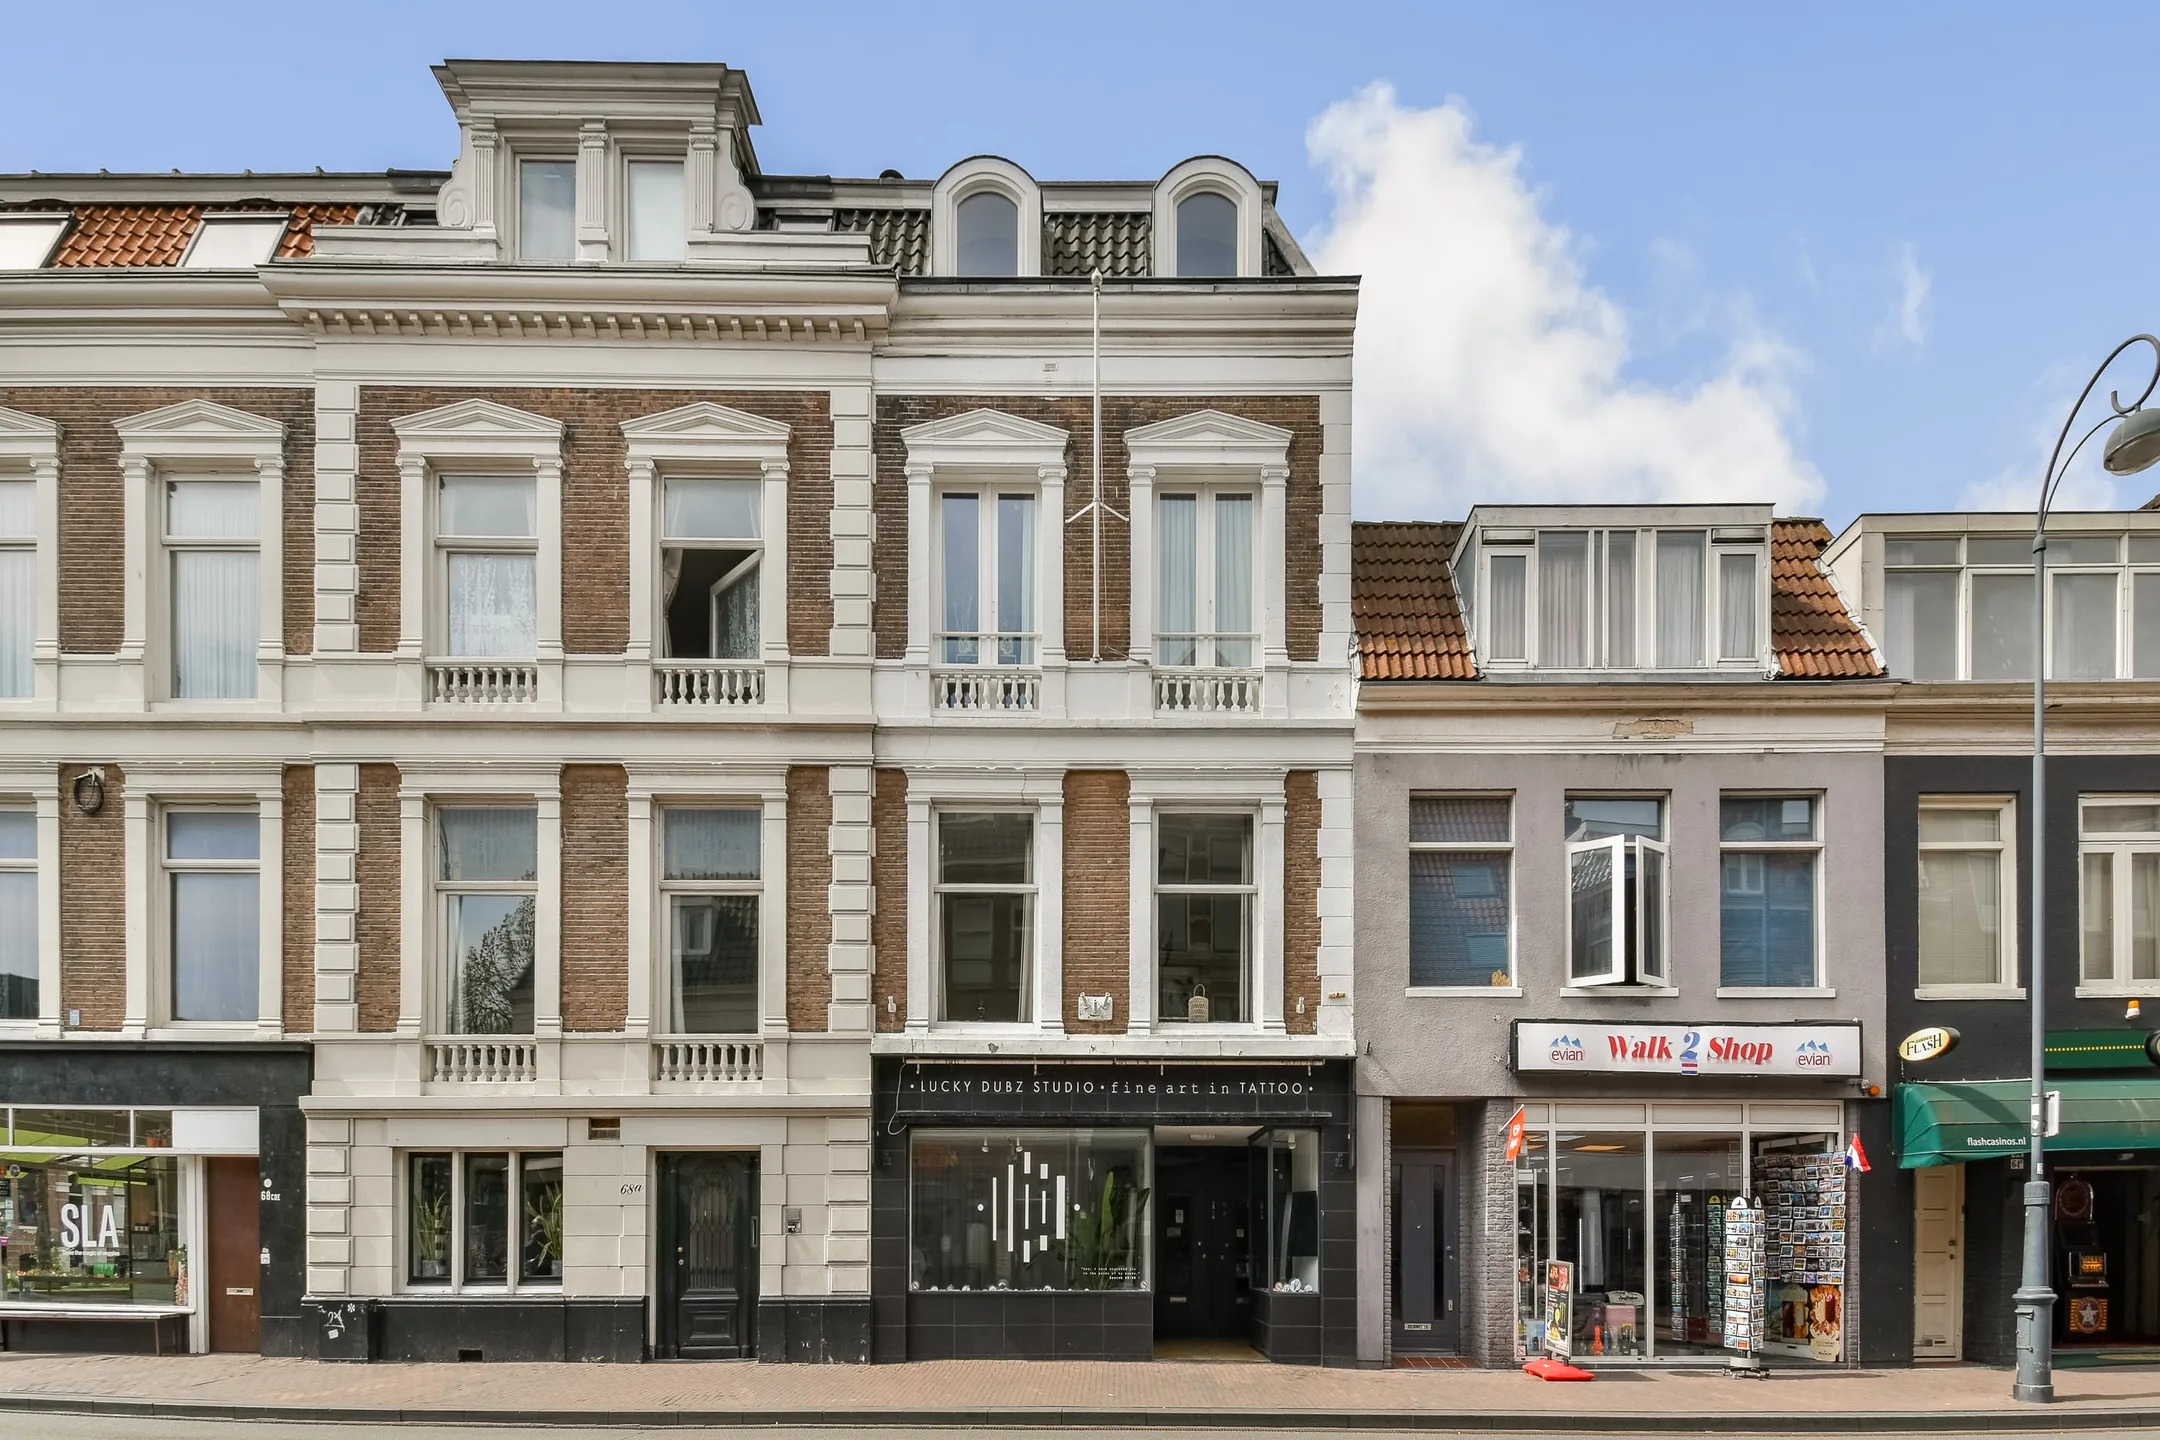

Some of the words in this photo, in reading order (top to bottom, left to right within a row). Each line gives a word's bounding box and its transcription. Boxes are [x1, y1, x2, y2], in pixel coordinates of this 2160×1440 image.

[1607, 1035, 1673, 1059] Walk
[1679, 1031, 1701, 1060] 2
[1706, 1036, 1773, 1065] Shop
[1906, 1033, 1942, 1056] FLASH
[1551, 1047, 1584, 1061] evian
[1798, 1052, 1831, 1066] evian
[920, 1080, 972, 1093] LUCKY
[981, 1080, 1024, 1093] DUBZ
[1033, 1081, 1094, 1093] STUDIO
[1111, 1082, 1157, 1094] fine
[1166, 1083, 1199, 1094] art
[1209, 1082, 1230, 1094] in
[1239, 1082, 1303, 1094] TATTOO
[1967, 1137, 2027, 1146] flashcasinos.nl
[620, 1183, 644, 1195] 68a
[61, 1203, 120, 1248] SLA
